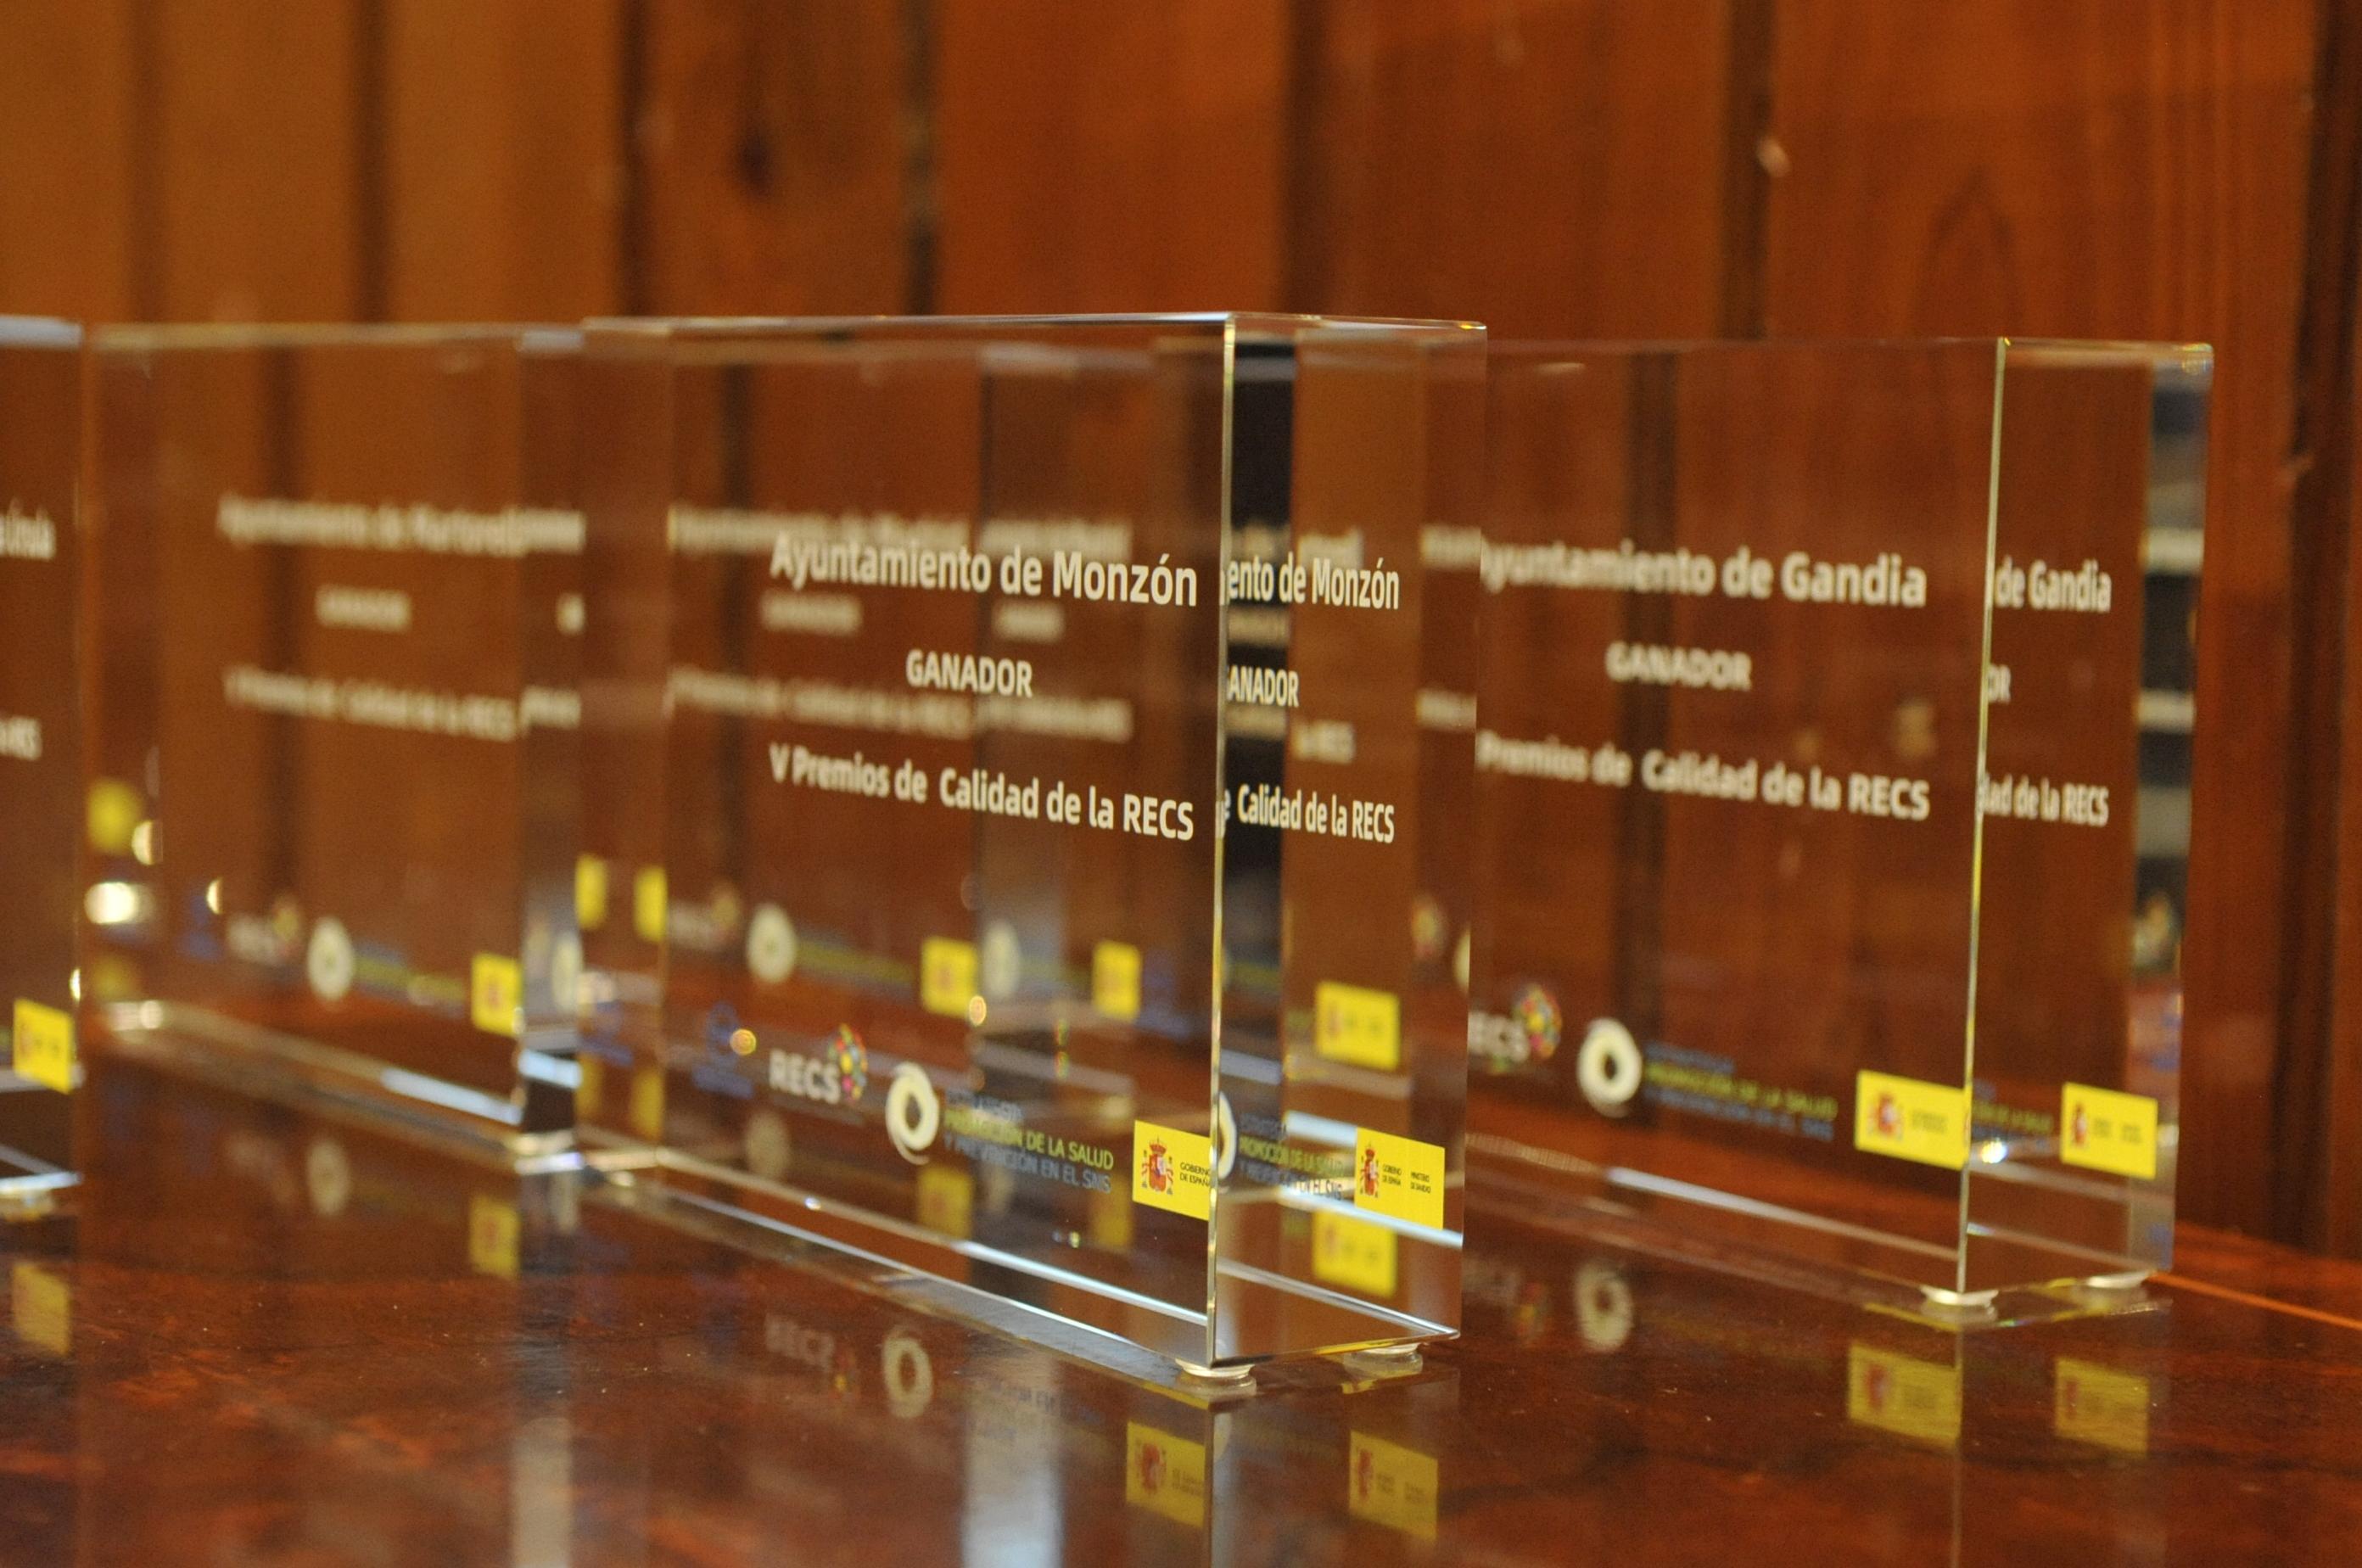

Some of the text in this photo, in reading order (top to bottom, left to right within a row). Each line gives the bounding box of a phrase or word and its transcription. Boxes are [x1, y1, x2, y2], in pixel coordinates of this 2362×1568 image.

[770, 529, 992, 592] Ayuntamiento
[999, 544, 1043, 596] de
[1053, 551, 1197, 607] Monzón
[1227, 552, 1399, 609] ento de Monzón
[1721, 544, 1775, 600] de
[1780, 551, 1928, 608] Gandia
[1994, 555, 2112, 613] de Gandia
[905, 648, 1033, 697] GANADOR
[1227, 664, 1299, 707] ANADOR
[1605, 641, 1752, 691] GANADOR
[770, 742, 1194, 841] V Premios de Calidad de la RECS
[1591, 742, 1633, 788] de
[1641, 749, 1758, 802] Calidad
[1761, 761, 1805, 806] de
[1809, 765, 1841, 810] la
[1847, 772, 1930, 820] RECS
[2062, 782, 2109, 827] RECS
[1237, 783, 1301, 830] Calidad
[1305, 791, 1328, 834] de
[1332, 794, 1347, 837] la
[1352, 799, 1395, 843] RECS
[769, 1049, 840, 1103] RECS
[1027, 1129, 1045, 1154] DE
[1049, 1135, 1065, 1159] LA
[1068, 1140, 1114, 1170] SALUD
